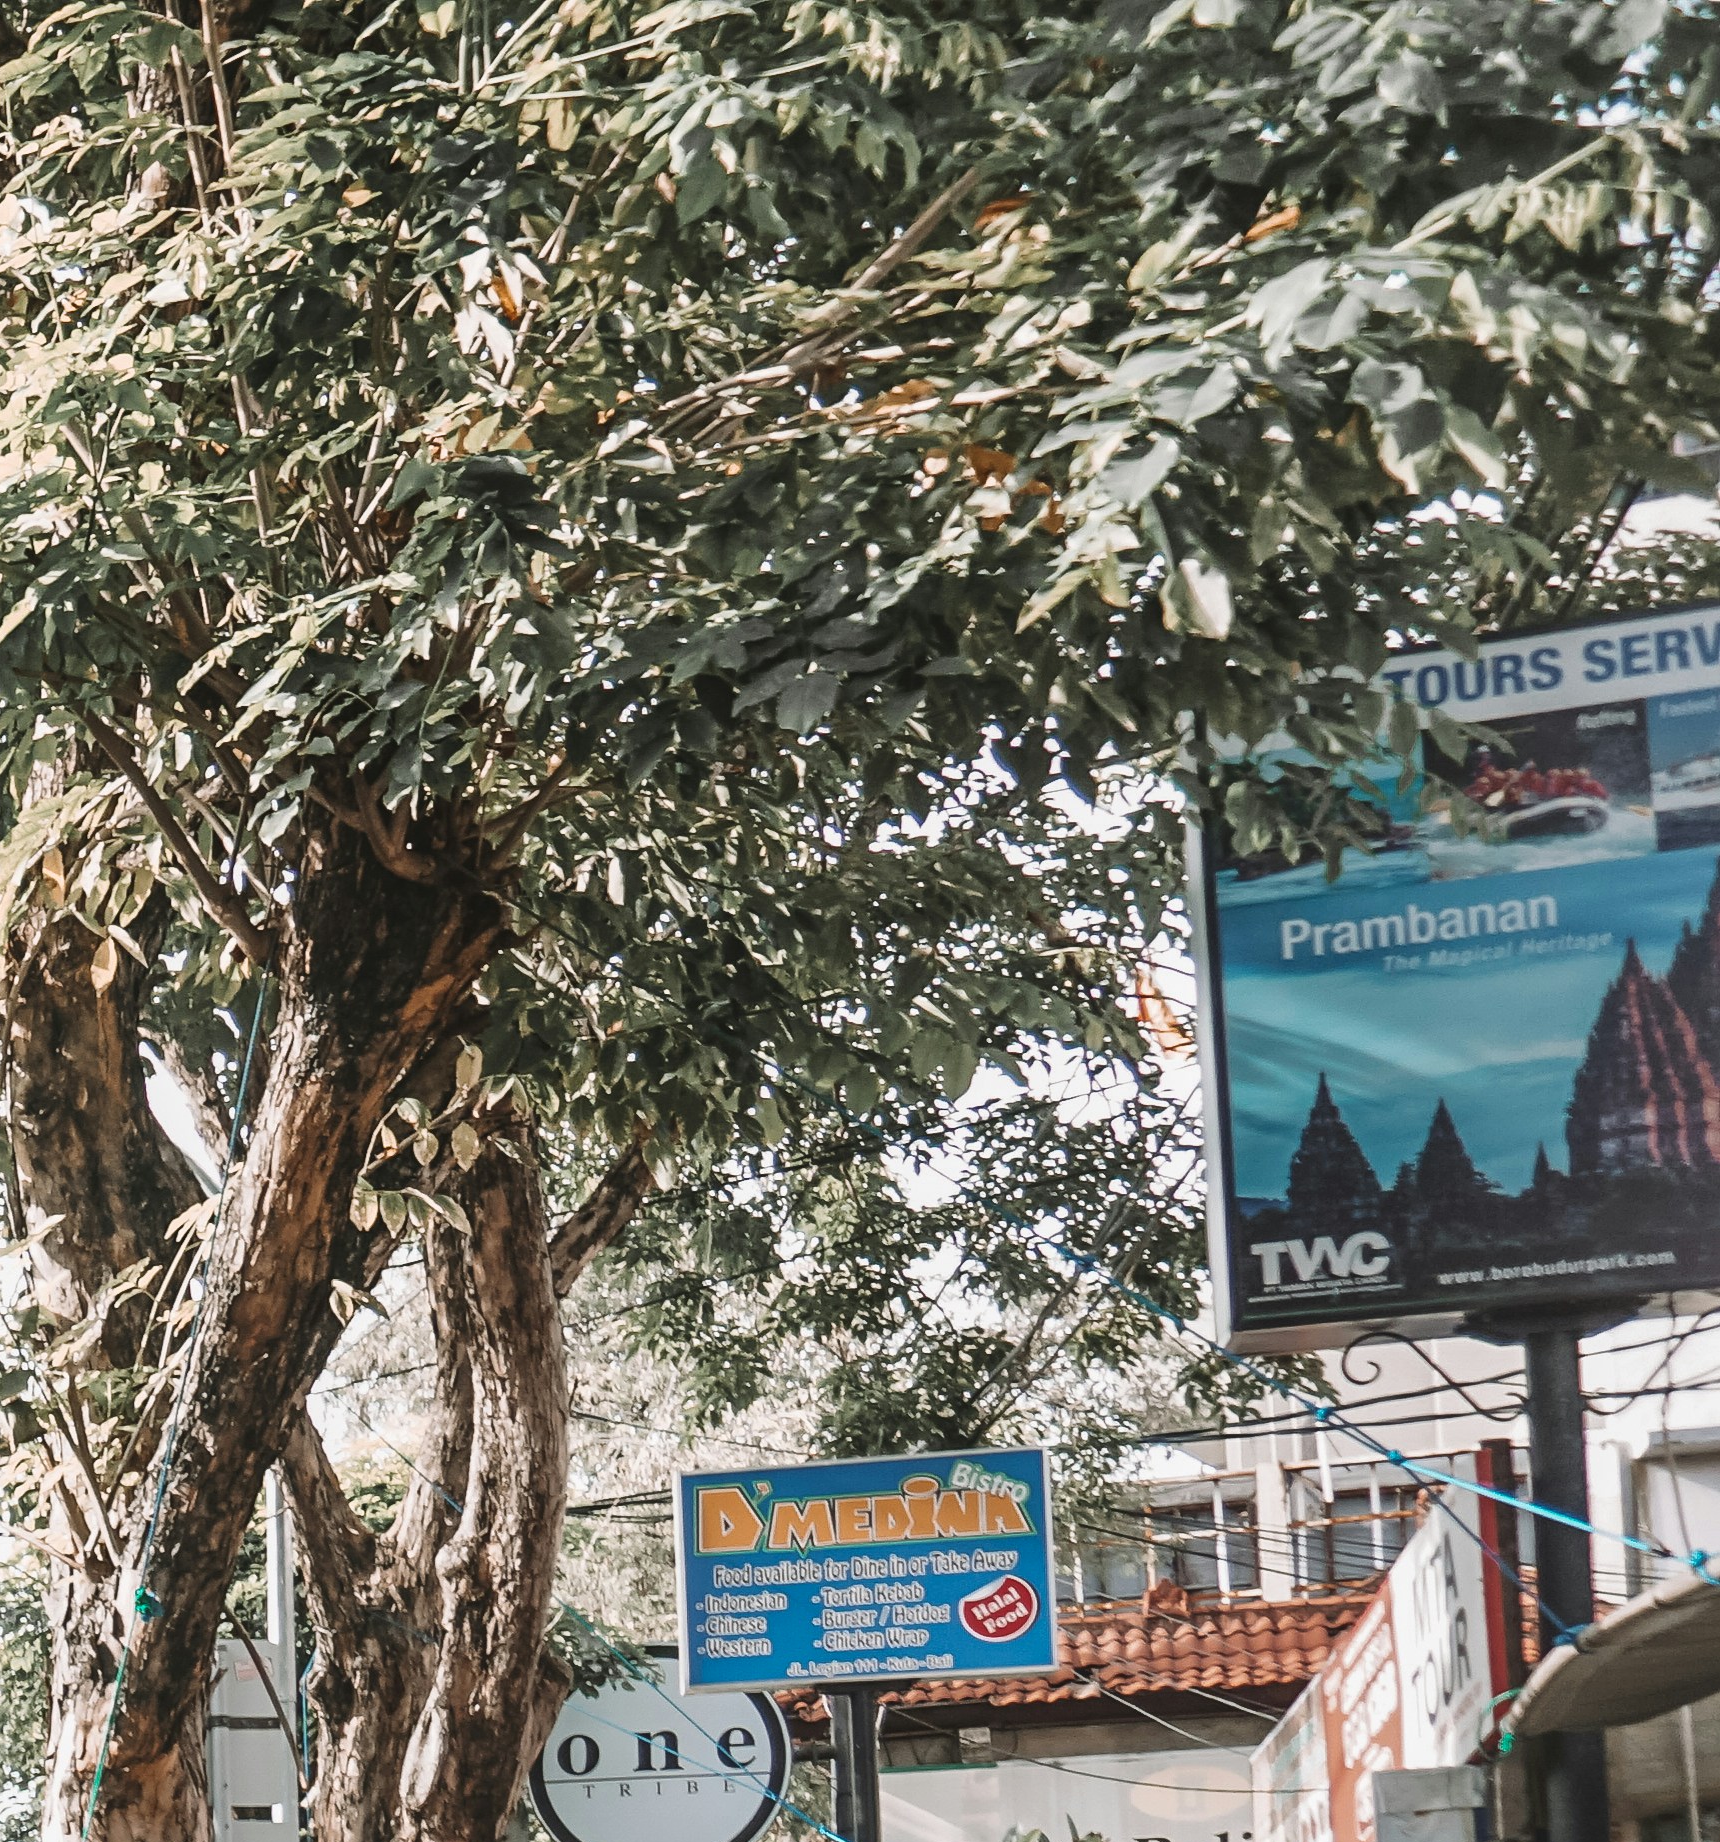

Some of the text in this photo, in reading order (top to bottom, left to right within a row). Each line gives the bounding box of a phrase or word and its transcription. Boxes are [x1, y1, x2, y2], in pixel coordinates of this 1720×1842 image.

[1382, 648, 1564, 708] TOURS
[1280, 895, 1558, 960] Prambanan
[1382, 932, 1614, 972] The Magical Heritage
[1250, 1231, 1390, 1285] TWC
[951, 1461, 1030, 1504] Bistro
[697, 1475, 1036, 1555] D'MEDINA
[714, 1550, 1018, 1588] Food available for Dine in or Take Away
[705, 1592, 788, 1613] Indonesian
[874, 1581, 925, 1603] Kebab
[971, 1585, 1021, 1621] Halal
[706, 1616, 768, 1636] Chinese
[822, 1610, 878, 1631] Burger
[892, 1604, 951, 1625] Hotdog
[983, 1605, 1030, 1636] Food
[706, 1638, 772, 1659] Western
[822, 1628, 930, 1652] Chicken Wrap
[557, 1727, 756, 1776] one
[583, 1779, 736, 1799] TRIBE
